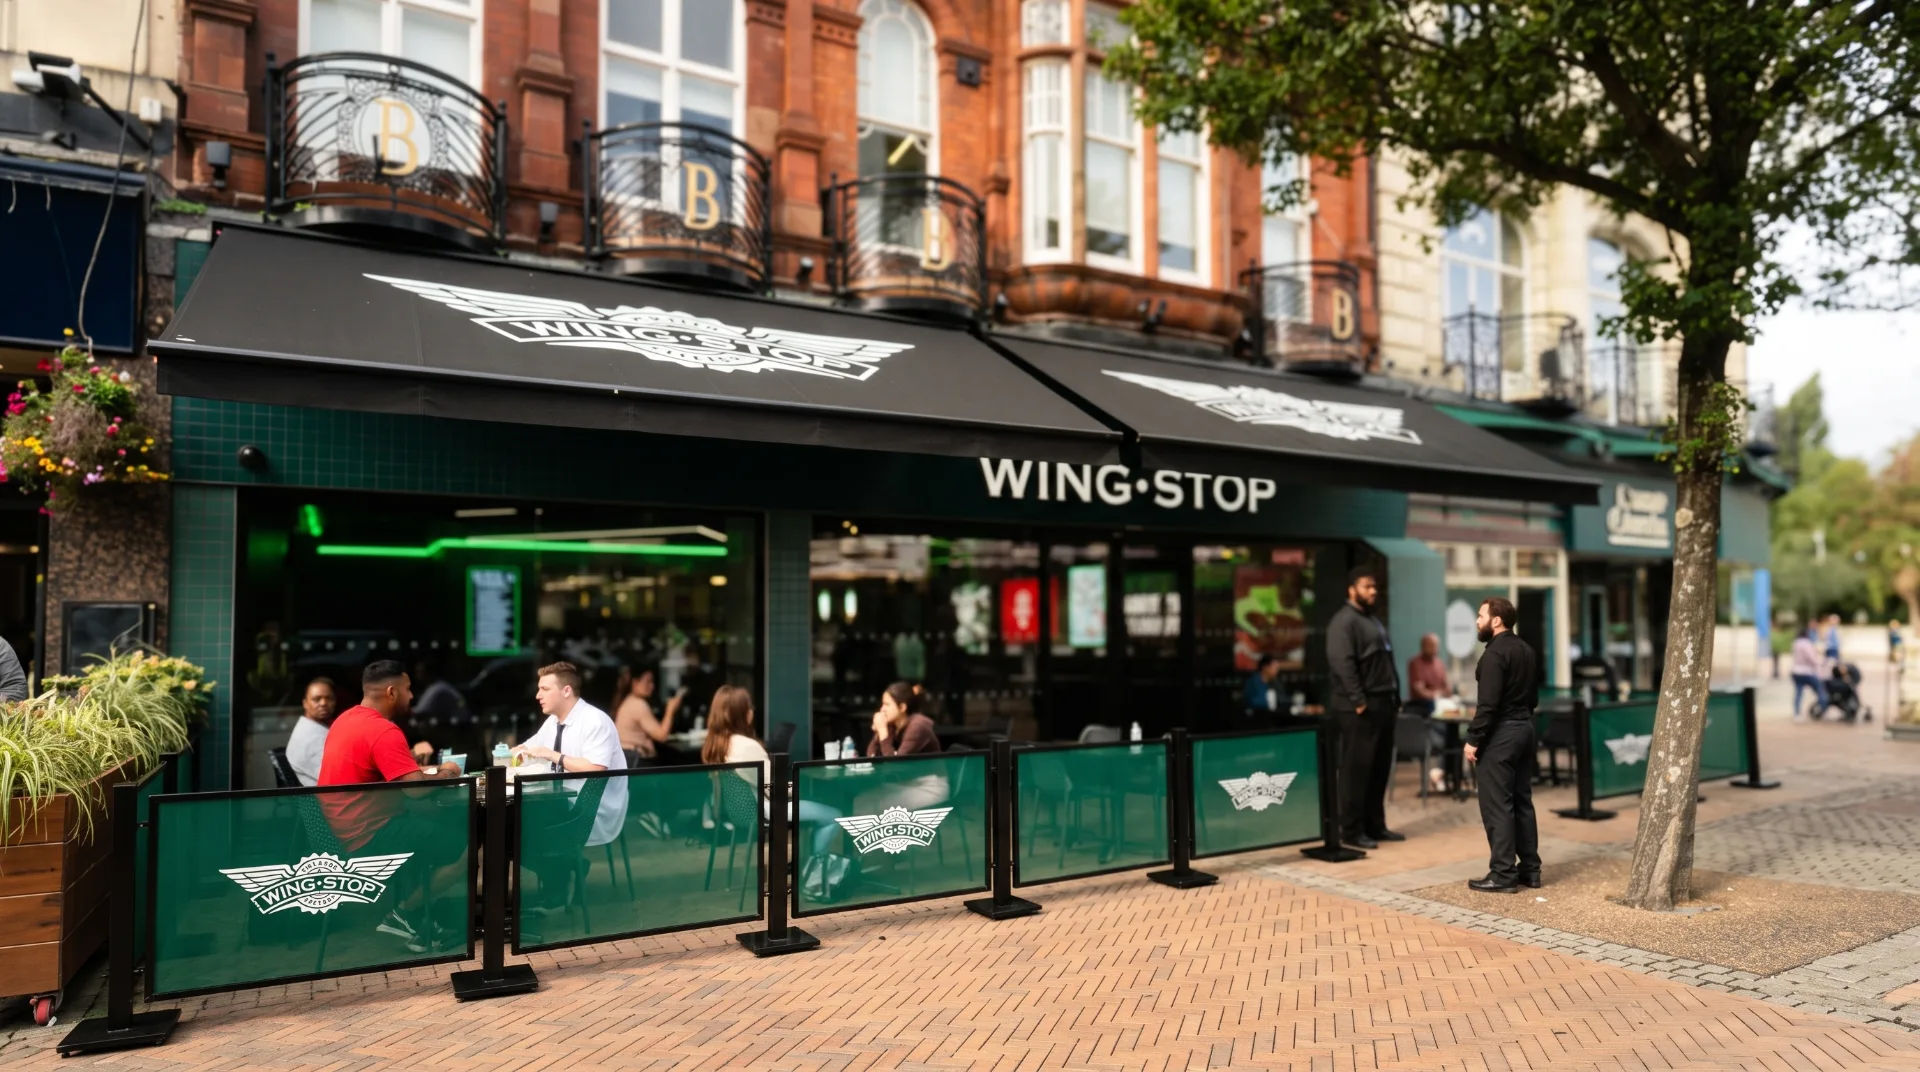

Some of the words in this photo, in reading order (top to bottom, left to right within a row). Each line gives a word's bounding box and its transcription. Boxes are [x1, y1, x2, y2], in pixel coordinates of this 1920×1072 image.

[374, 98, 419, 175] B
[682, 161, 719, 230] B
[1331, 287, 1354, 340] B
